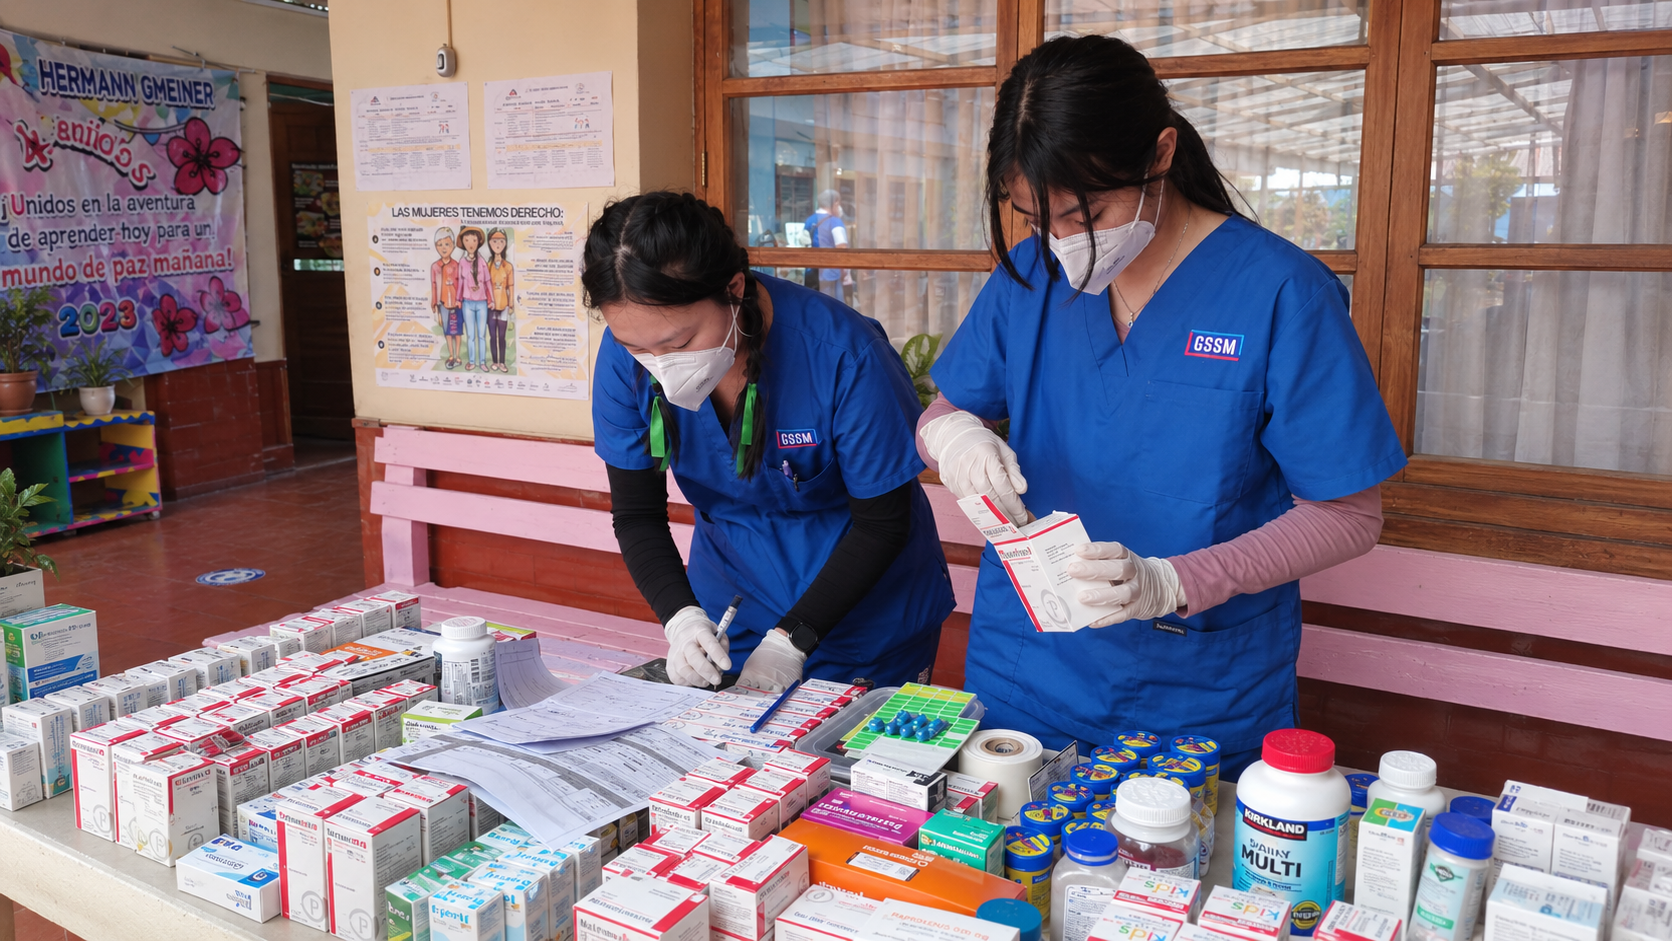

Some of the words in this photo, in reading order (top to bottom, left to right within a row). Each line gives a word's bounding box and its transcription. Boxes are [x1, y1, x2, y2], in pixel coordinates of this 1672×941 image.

[38, 59, 137, 98] HERMANN
[141, 75, 215, 105] GMEINER
[82, 199, 101, 213] en
[107, 193, 122, 212] la
[127, 194, 196, 212] aventura
[391, 207, 410, 218] LAS
[412, 207, 459, 218] MUJERES
[460, 207, 509, 218] TENEMOS
[511, 207, 564, 218] DERECHO:
[8, 227, 32, 249] de
[38, 225, 116, 252] aprender
[157, 224, 190, 244] para
[2, 258, 77, 288] mundo
[83, 255, 106, 279] de
[113, 256, 147, 282] paz
[154, 247, 233, 272] mañana!
[58, 299, 137, 338] 2023
[1194, 335, 1237, 355] GSSM
[781, 432, 813, 445] GSSM
[1244, 808, 1305, 834] KIRKLAND
[1241, 843, 1302, 878] MULTI
